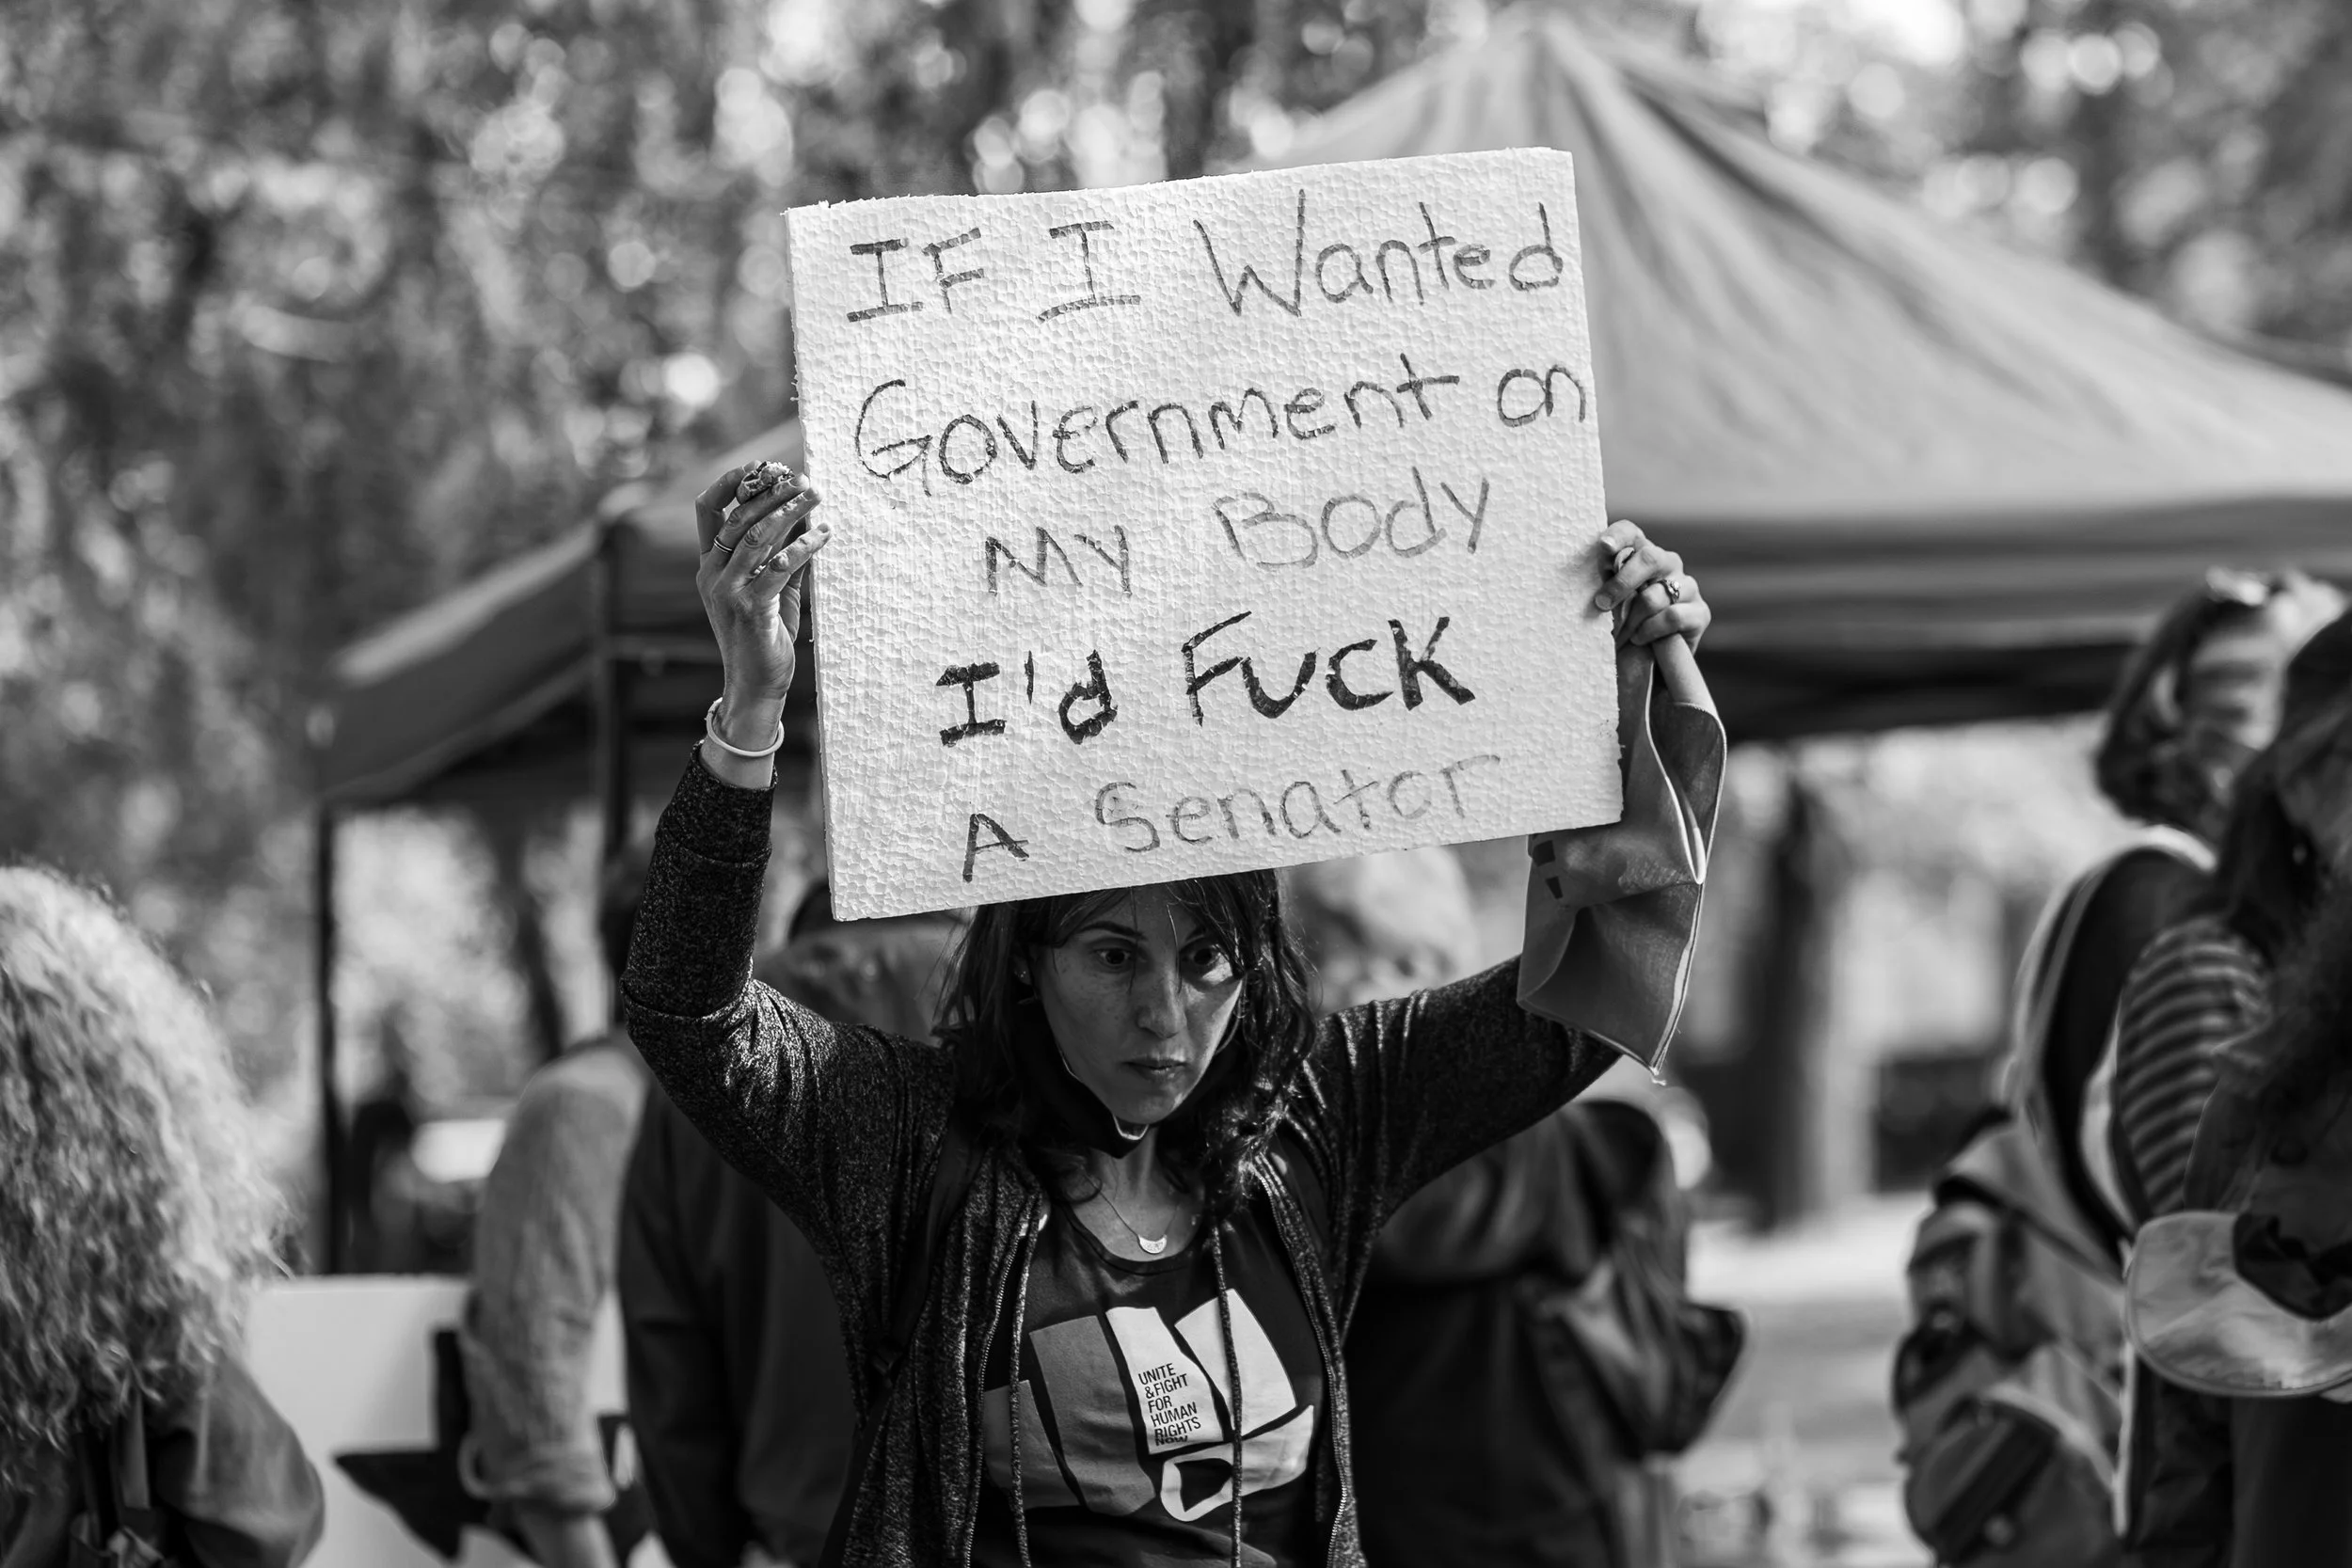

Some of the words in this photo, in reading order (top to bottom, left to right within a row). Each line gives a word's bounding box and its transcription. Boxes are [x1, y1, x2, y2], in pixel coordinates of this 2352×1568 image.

[847, 227, 985, 322] IF
[1038, 220, 1141, 322] I
[1193, 189, 1565, 316] Wanted
[854, 353, 1460, 497] Government
[1497, 363, 1587, 428] on
[936, 649, 1120, 747] I'd
[962, 813, 1030, 883] A
[1094, 754, 1502, 853] Senator
[1138, 1363, 1176, 1385] UNITE
[1148, 1395, 1173, 1413] FOR
[1151, 1402, 1198, 1427] HUMAN
[1154, 1417, 1201, 1438] RIGHTS
